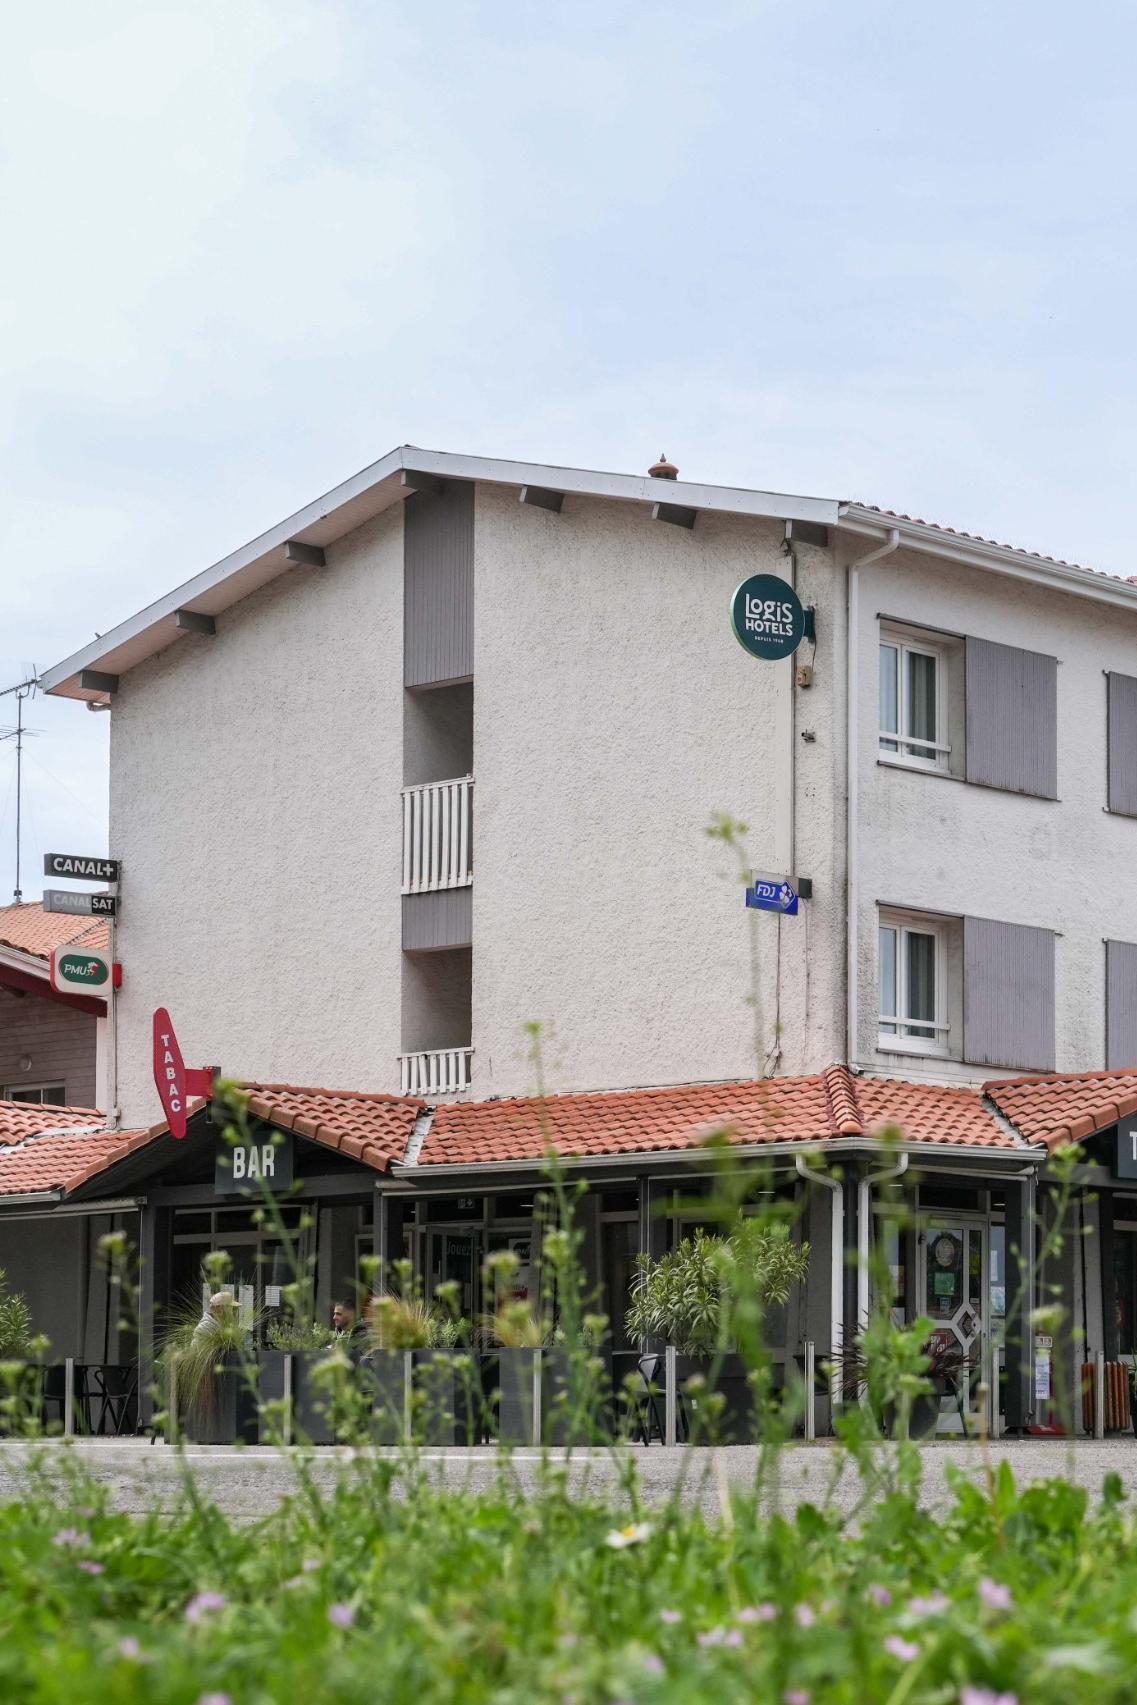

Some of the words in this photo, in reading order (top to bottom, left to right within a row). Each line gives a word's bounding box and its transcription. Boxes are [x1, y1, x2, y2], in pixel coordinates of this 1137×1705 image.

[745, 618, 793, 636] HOTELS
[53, 857, 114, 877] CANAL+
[757, 884, 777, 898] FDJ
[64, 963, 87, 976] PMU
[161, 1034, 182, 1112] TABAC
[233, 1144, 275, 1179] BAR
